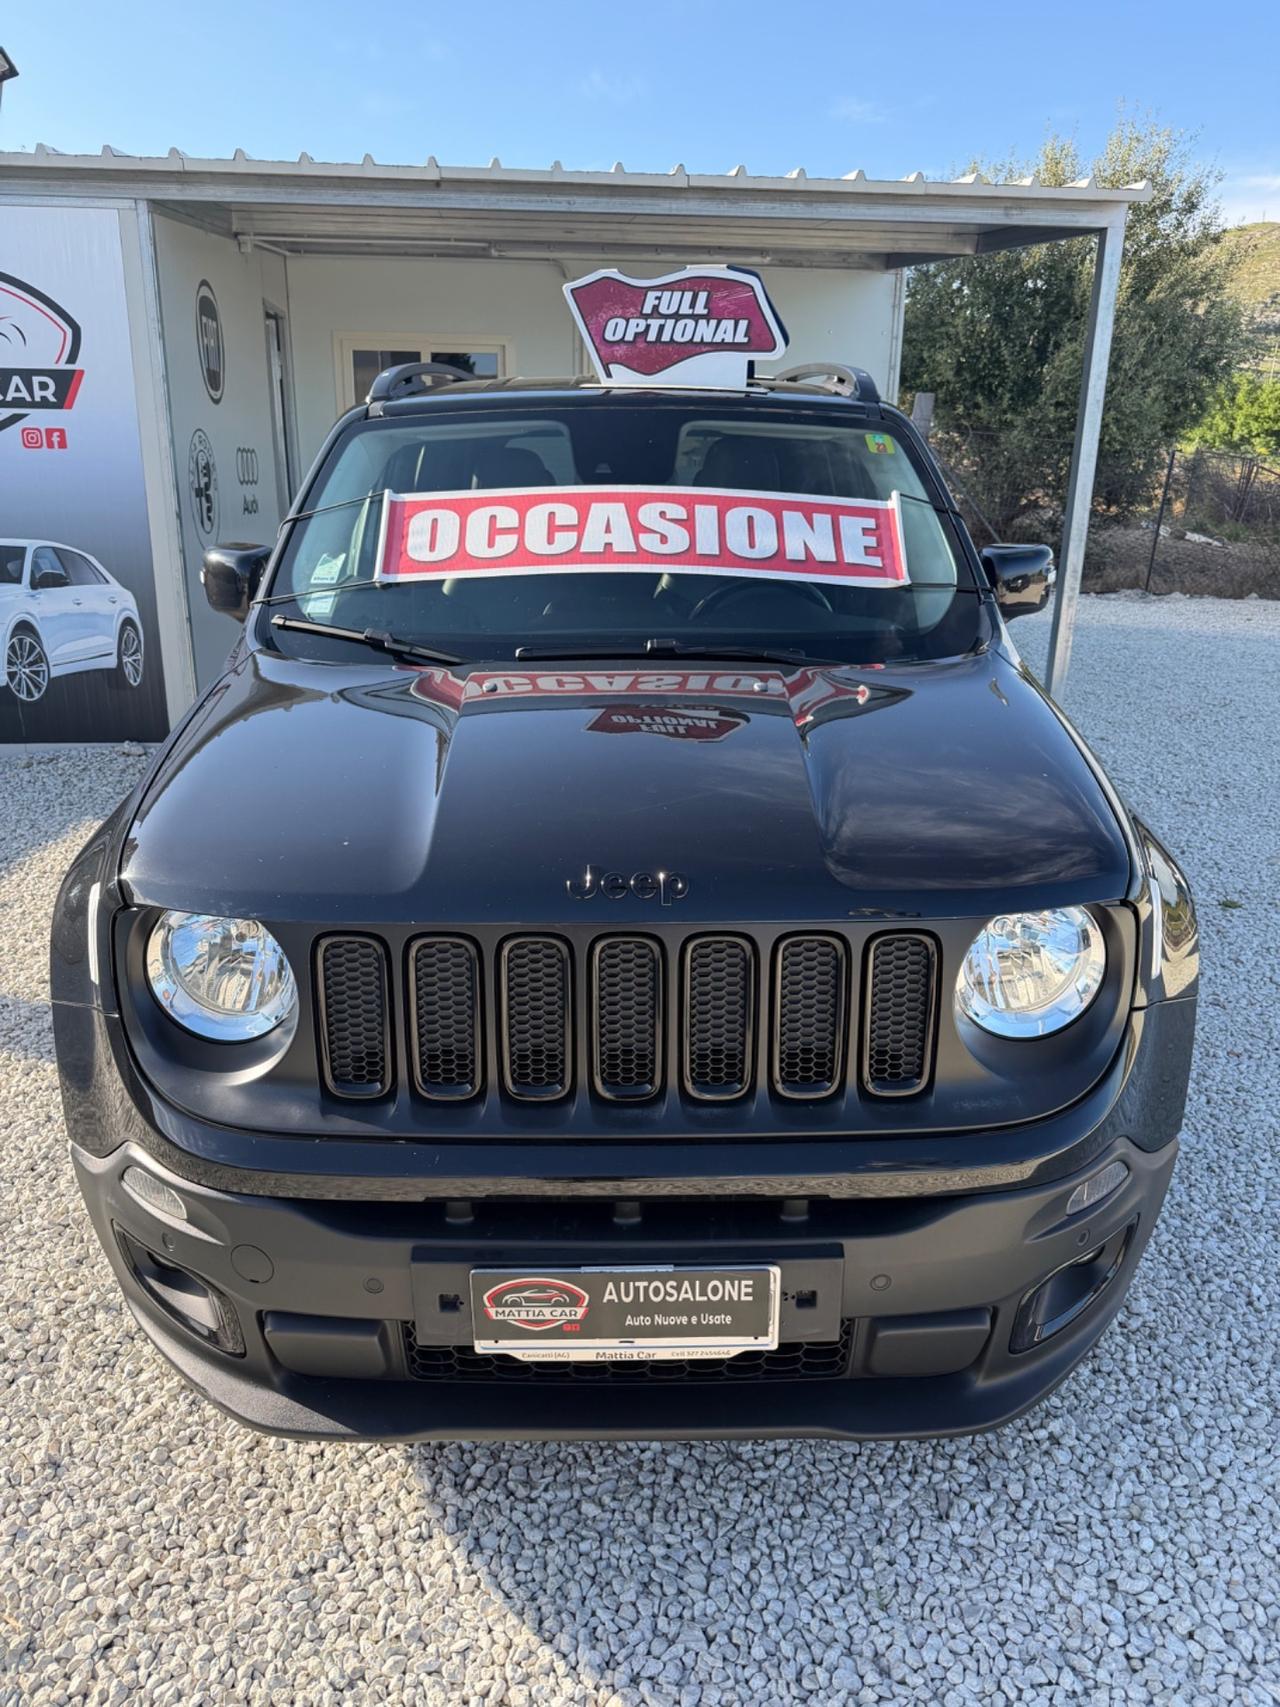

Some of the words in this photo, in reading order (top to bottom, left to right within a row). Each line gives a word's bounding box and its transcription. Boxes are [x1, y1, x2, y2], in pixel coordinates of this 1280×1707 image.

[641, 290, 709, 315] FULL
[604, 318, 749, 343] OPTIONAL
[0, 375, 57, 402] AR
[406, 502, 884, 568] OCCASIONE
[564, 864, 689, 906] Jeep
[602, 1280, 754, 1303] AUTOSALONE
[495, 1309, 546, 1318] MATTIA
[550, 1309, 578, 1318] CAR
[625, 1314, 652, 1326] Auto
[654, 1314, 688, 1326] Nuove
[691, 1316, 698, 1325] e
[701, 1313, 732, 1325] Usate
[595, 1351, 634, 1360] Mattia
[637, 1350, 657, 1360] Car
